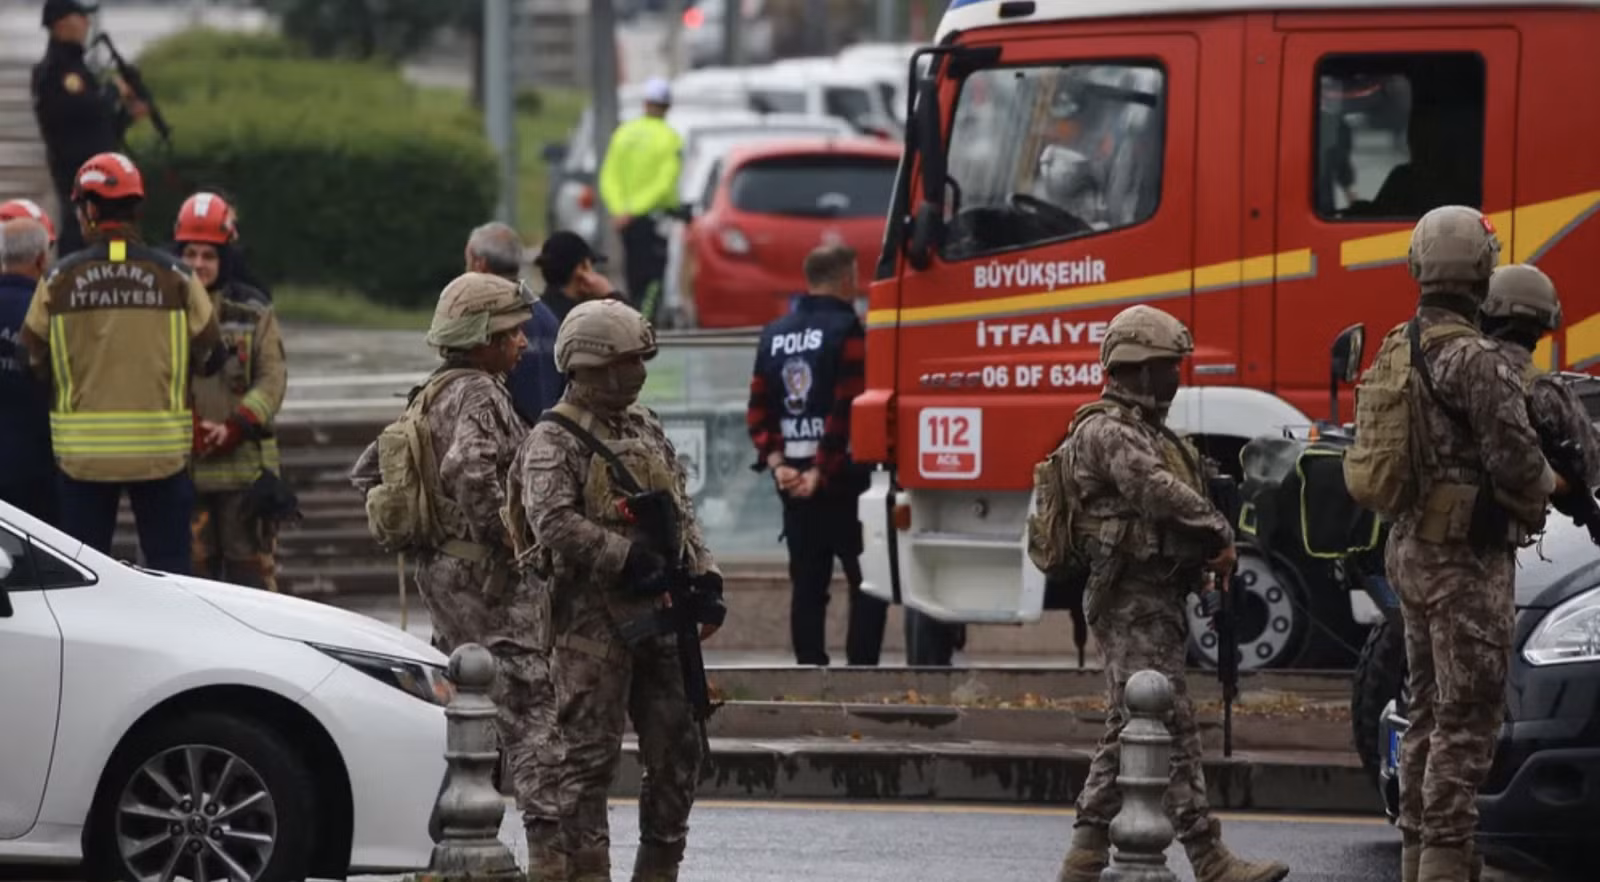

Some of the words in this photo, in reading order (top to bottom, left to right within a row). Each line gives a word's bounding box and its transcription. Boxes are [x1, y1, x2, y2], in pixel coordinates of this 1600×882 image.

[75, 263, 154, 290] ANKARA
[974, 256, 1106, 290] BÜYÜKŞEHİR
[771, 328, 823, 357] POLİS
[977, 318, 1107, 347] İTFAİYE
[983, 366, 1009, 386] 06
[1016, 366, 1043, 387] DF
[1051, 363, 1103, 386] 6348
[928, 416, 970, 446] 112
